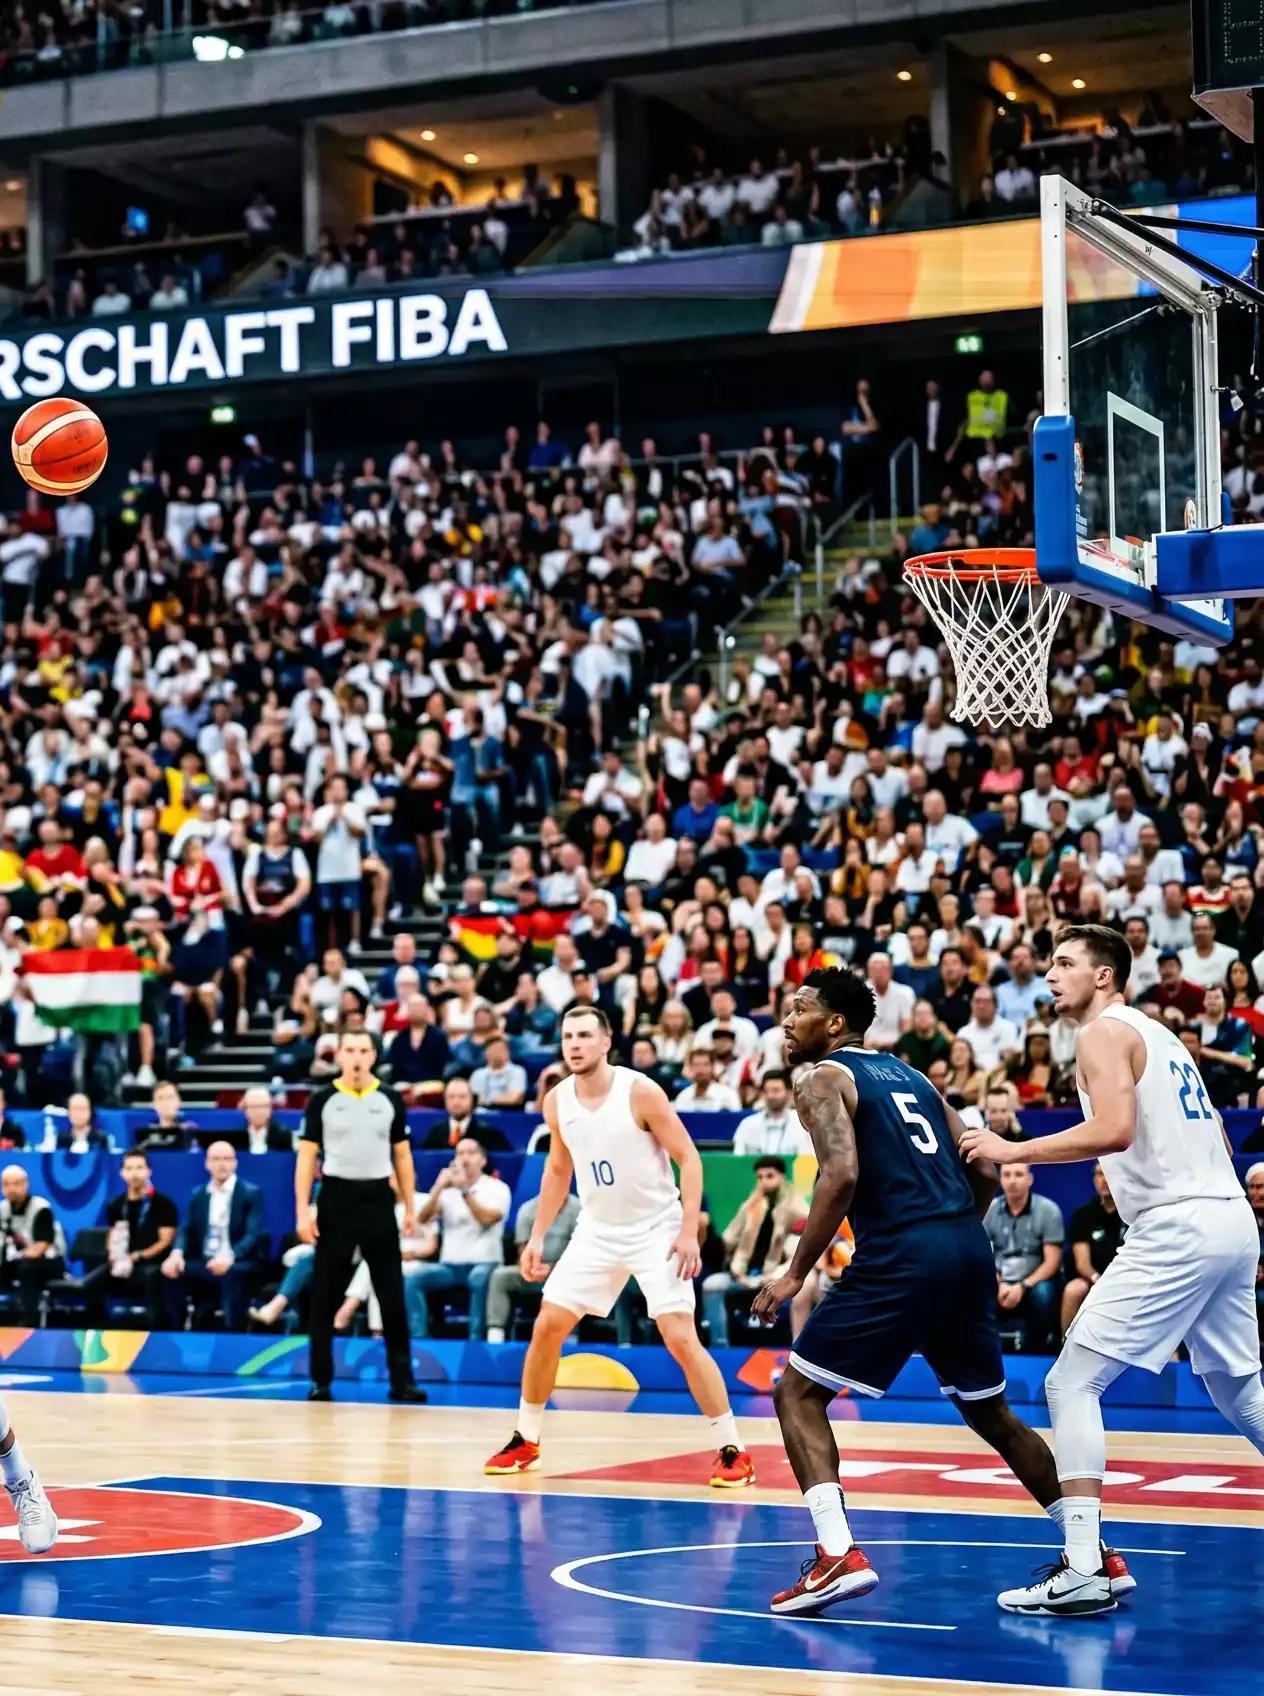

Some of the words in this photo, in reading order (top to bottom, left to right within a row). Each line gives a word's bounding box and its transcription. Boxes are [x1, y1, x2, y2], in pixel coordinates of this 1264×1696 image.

[331, 288, 509, 367] FIBA
[1169, 1060, 1213, 1120] 22
[890, 1091, 939, 1154] 5
[591, 1160, 615, 1187] 10
